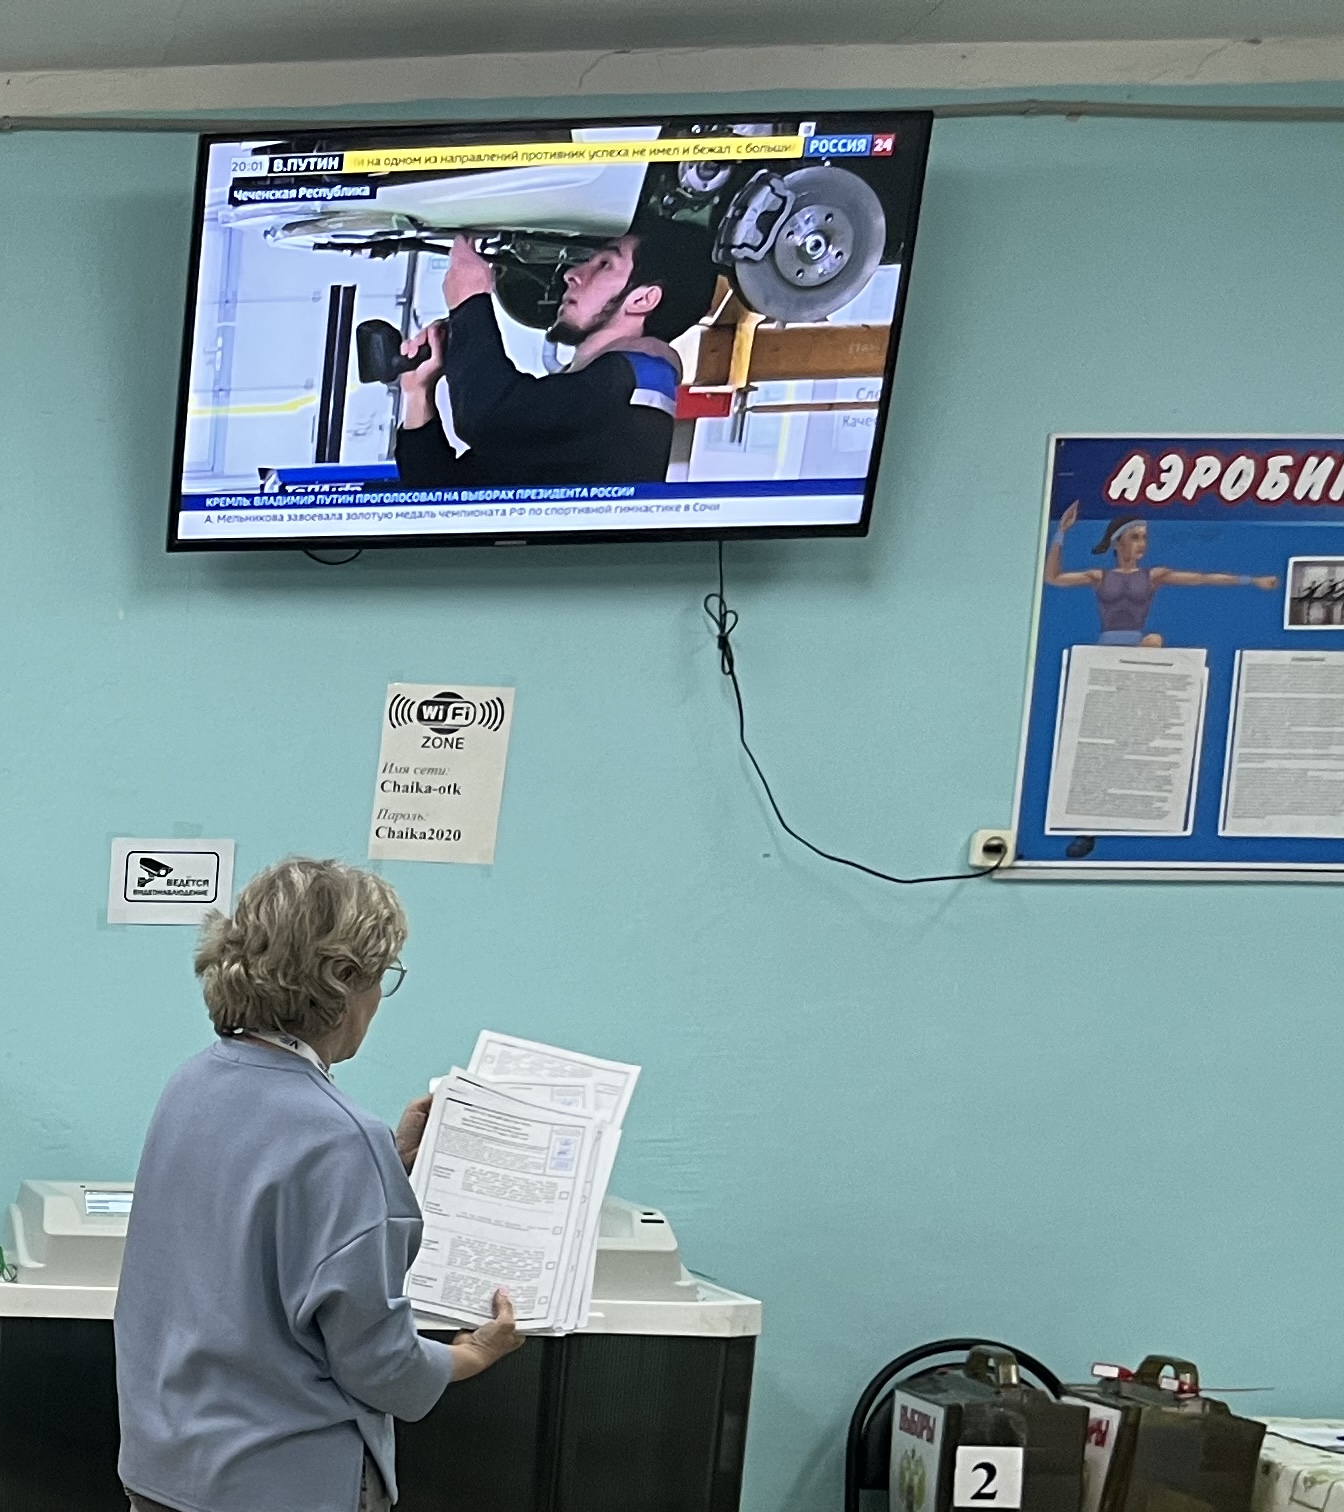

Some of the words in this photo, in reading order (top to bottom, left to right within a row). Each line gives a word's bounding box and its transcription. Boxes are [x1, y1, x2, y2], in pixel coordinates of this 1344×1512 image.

[809, 138, 867, 153] РОССИЯ
[873, 138, 892, 152] 24
[367, 157, 381, 167] на
[384, 157, 422, 167] одном
[425, 155, 437, 164] из
[440, 150, 518, 164] направлений
[521, 149, 585, 161] противник
[588, 149, 629, 160] успеха
[632, 147, 646, 156] не
[649, 146, 679, 155] имел
[693, 142, 730, 154] бежал
[231, 160, 263, 172] 20:01
[273, 156, 339, 172] В.ПУТИН
[234, 187, 297, 202] Чеченская
[299, 184, 370, 200] Республика
[253, 495, 315, 506] ВЛАДИМИР
[316, 494, 354, 505] ПУТИН
[355, 492, 442, 504] ПРОГОЛОСОВАЛ
[443, 491, 459, 501] НА
[461, 490, 515, 501] ВЫБОРАХ
[516, 487, 589, 500] ПРЕЗИДЕНТА
[590, 486, 635, 498] РОССИИ
[217, 513, 284, 523] Мельникова
[287, 512, 342, 522] завоевала
[346, 511, 393, 521] золотую
[395, 510, 436, 520] медаль
[439, 508, 506, 518] чемпионата
[509, 507, 526, 517] РФ
[545, 504, 612, 515] спортивной
[614, 503, 681, 514] гимнастике
[421, 736, 465, 750] ZONE
[381, 762, 410, 775] Имя
[380, 779, 462, 796] Chaika-otk
[375, 825, 462, 842] Chaika2020
[970, 1461, 999, 1501] 2
